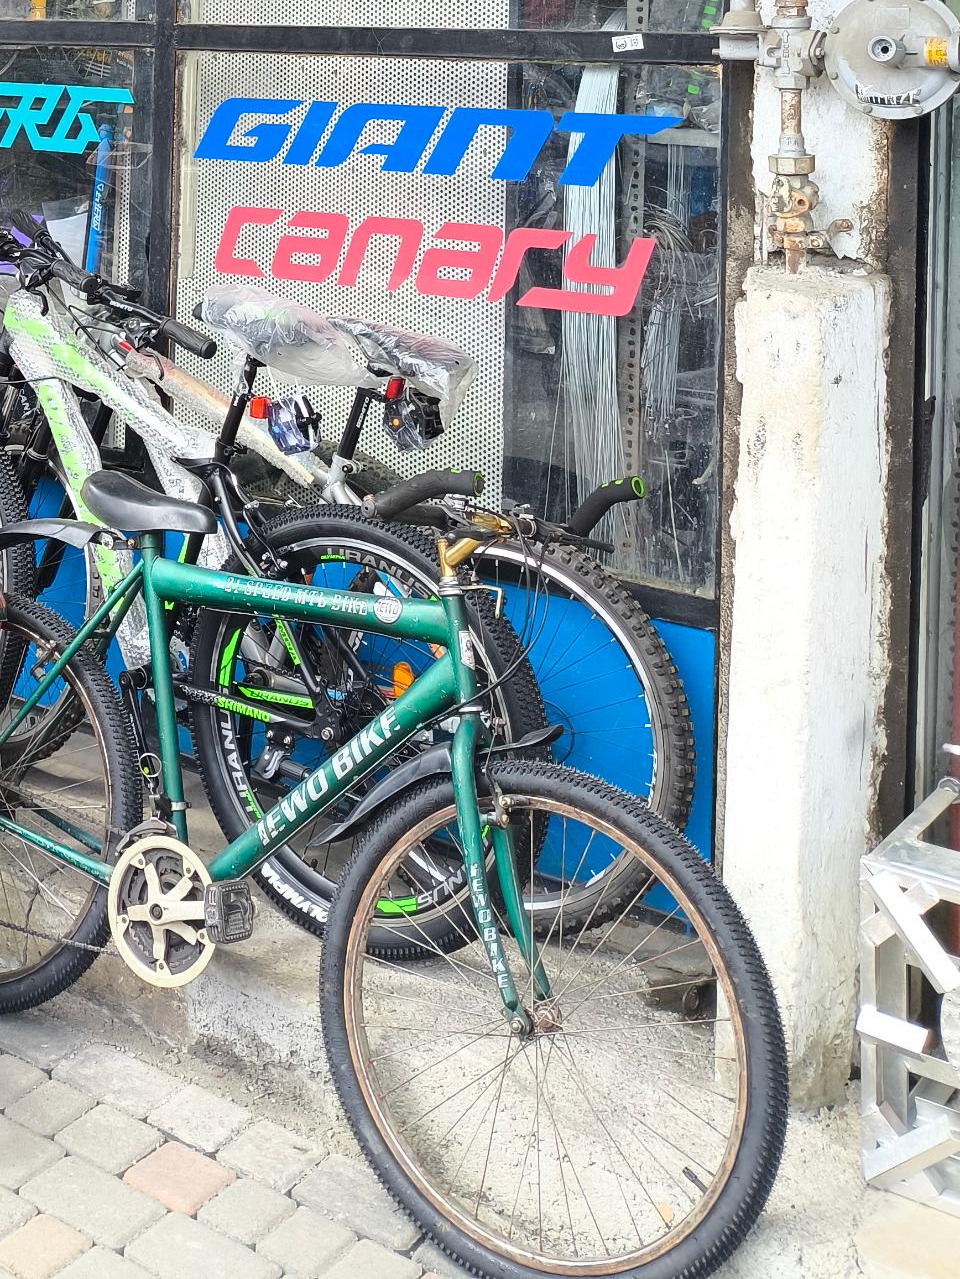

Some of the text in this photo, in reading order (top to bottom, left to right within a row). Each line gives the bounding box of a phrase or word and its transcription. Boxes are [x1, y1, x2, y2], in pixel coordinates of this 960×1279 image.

[193, 97, 685, 187] GIANT
[326, 547, 431, 599] URANUS
[216, 696, 271, 723] SHIMANO
[332, 706, 403, 783] BIKE
[482, 926, 510, 990] BIKE
